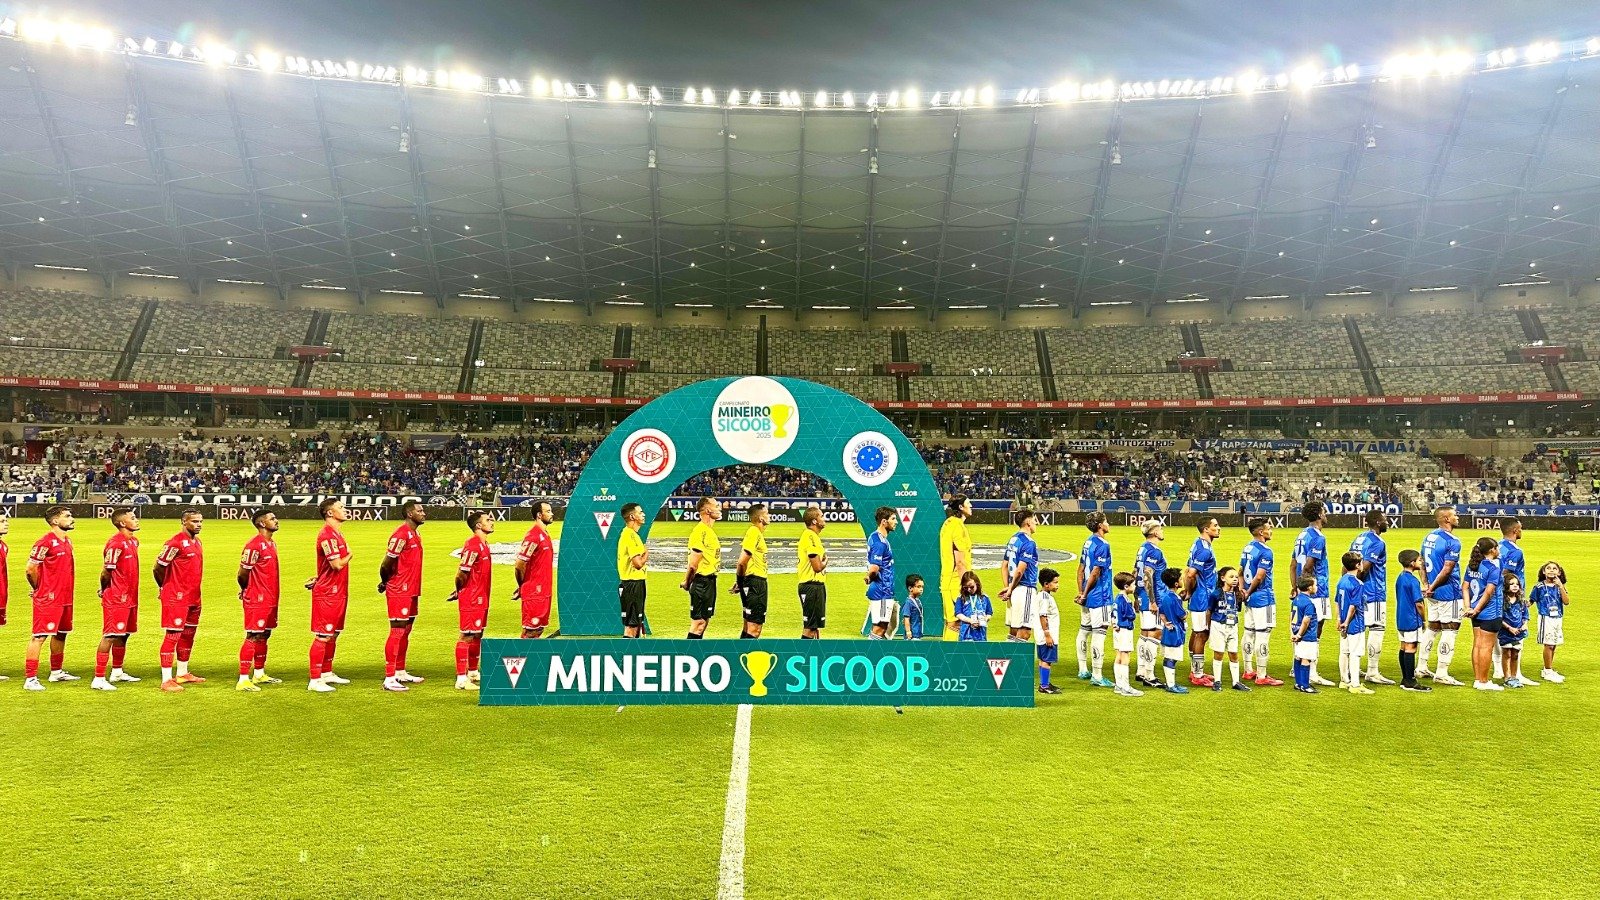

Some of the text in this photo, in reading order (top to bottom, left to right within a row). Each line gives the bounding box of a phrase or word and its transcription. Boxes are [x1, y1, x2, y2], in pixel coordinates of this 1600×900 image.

[718, 406, 770, 417] MINEIRO
[718, 418, 771, 432] SICOOB
[1476, 518, 1500, 529] BRA
[1424, 548, 1433, 572] 5
[546, 654, 967, 692] MINEIRO SICOOB 2025
